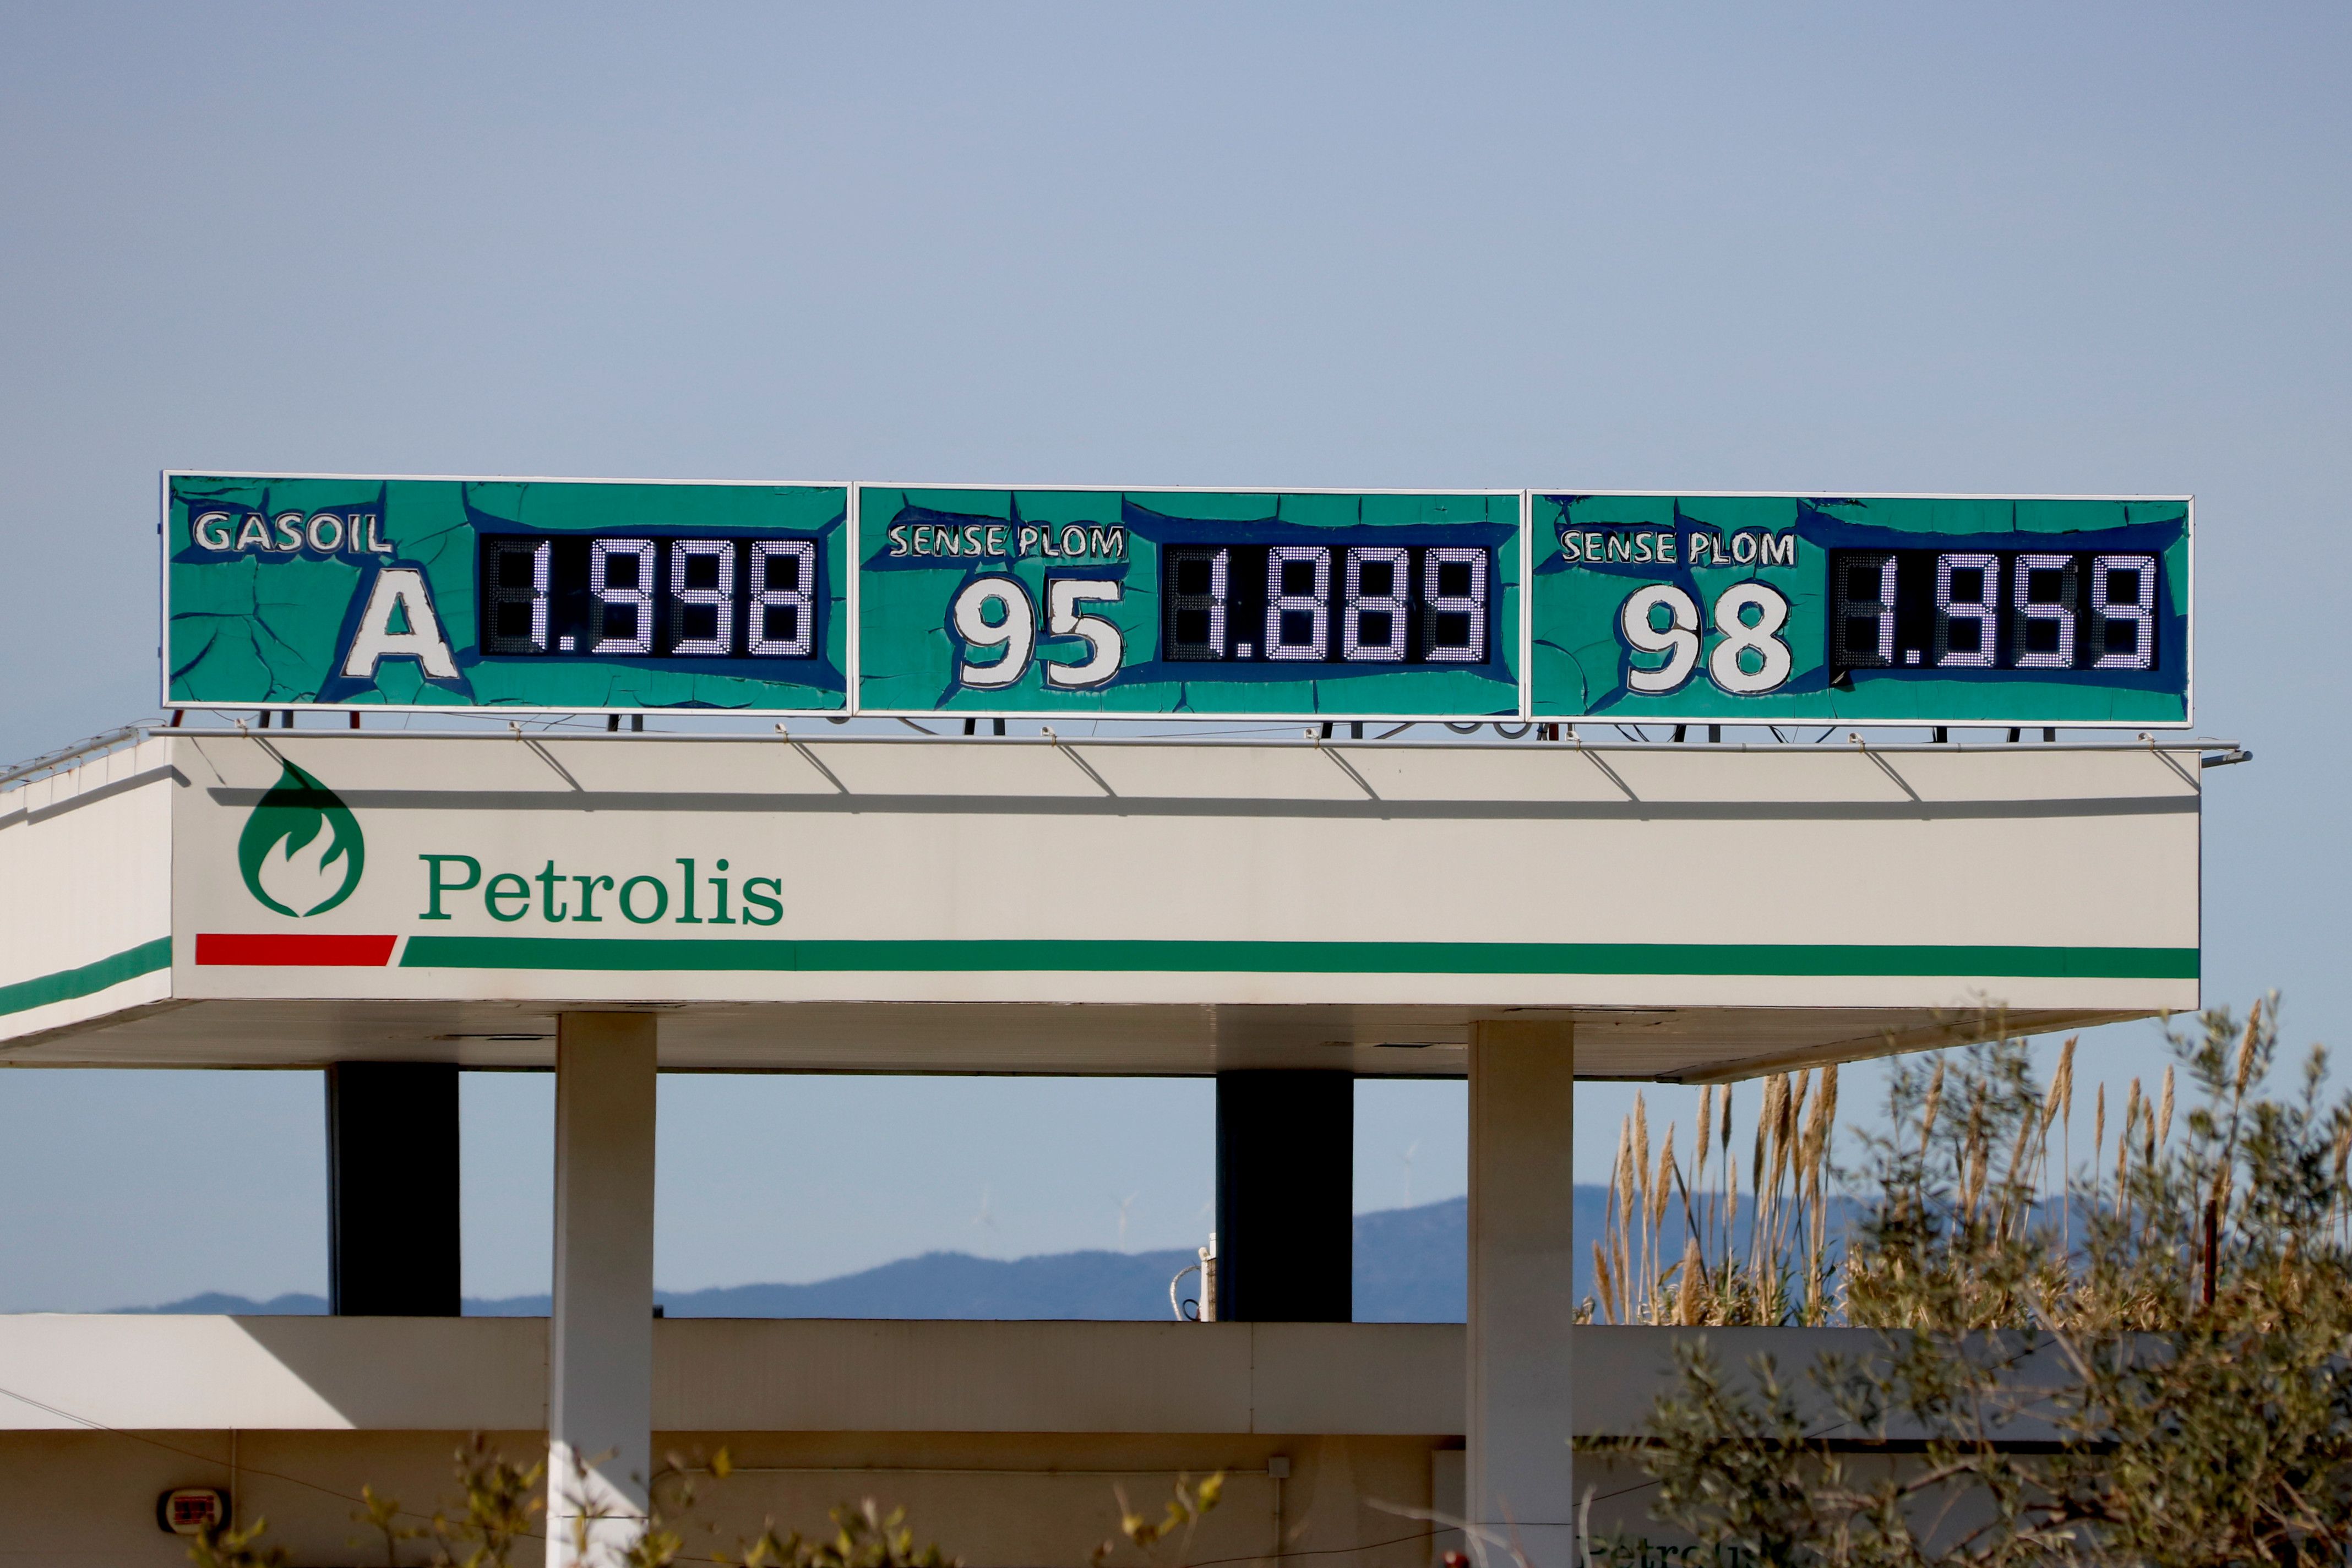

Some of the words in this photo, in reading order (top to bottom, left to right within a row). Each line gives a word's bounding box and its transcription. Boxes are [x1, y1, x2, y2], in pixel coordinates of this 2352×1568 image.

[193, 510, 394, 554] GASOIL
[889, 524, 1006, 557] SENSE
[1019, 524, 1124, 559] PLOM
[1561, 530, 1677, 564] SENSE
[1689, 531, 1797, 566] PLOM
[340, 568, 460, 678] A
[532, 538, 814, 655] 1.998
[952, 577, 1123, 690] 95
[1210, 546, 1486, 661] 1.889
[1619, 581, 1792, 695] 98
[1878, 554, 2155, 668] 1.959
[418, 854, 784, 926] Petrolis
